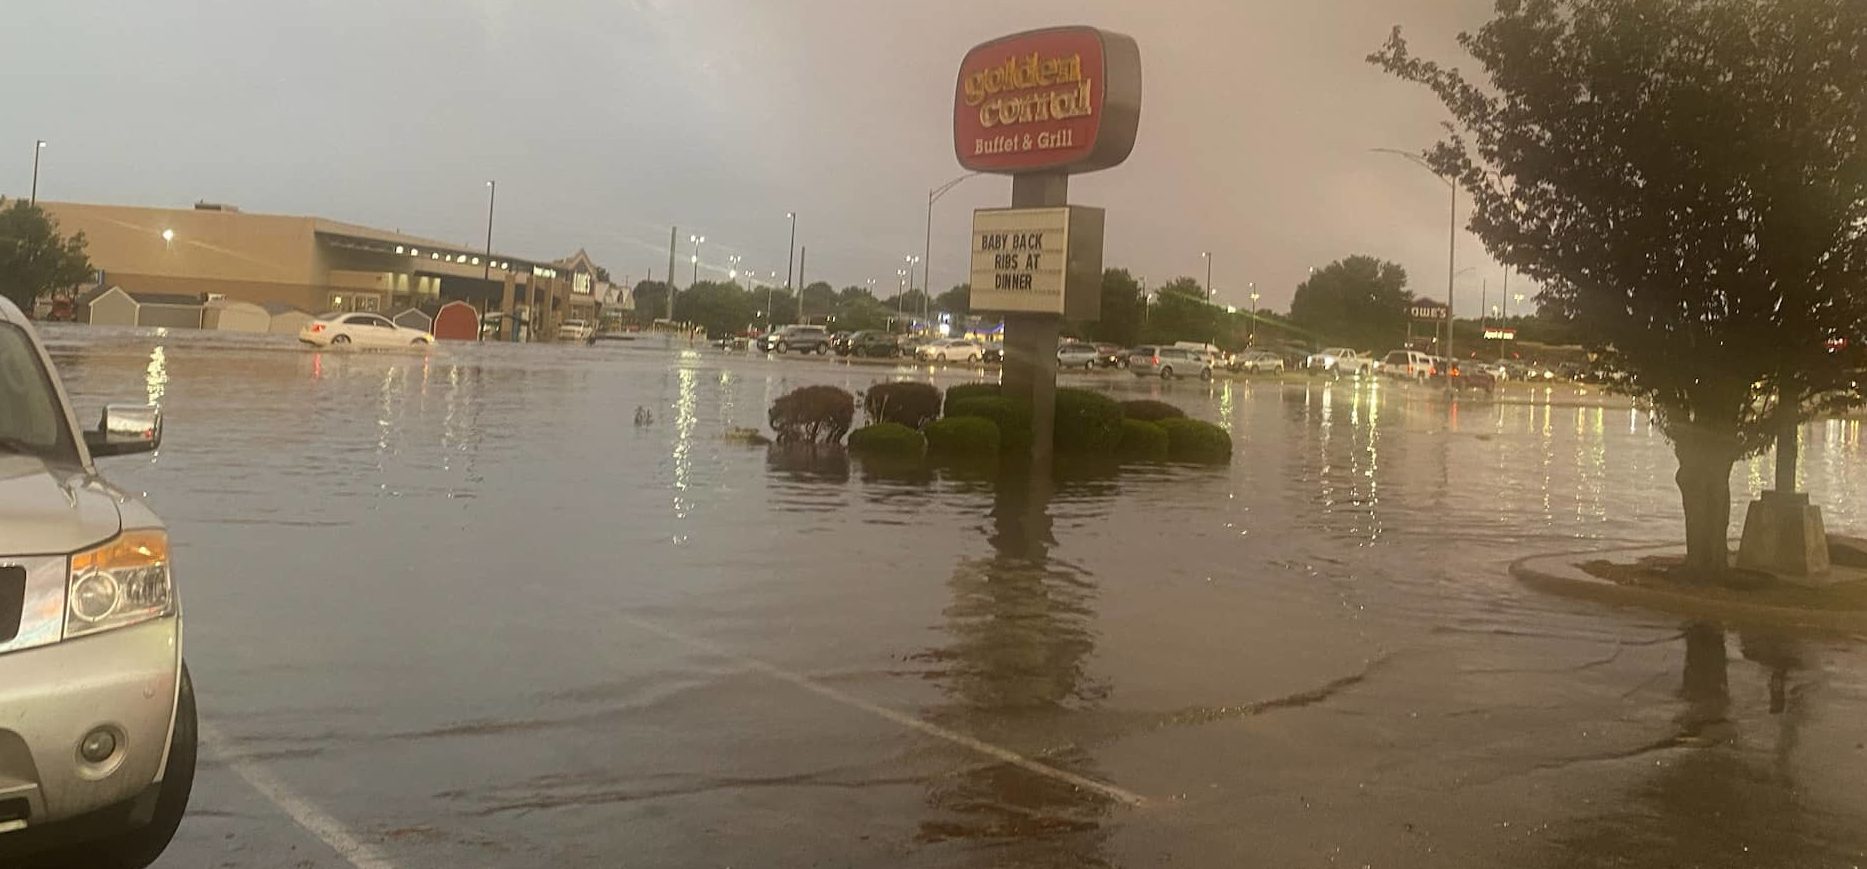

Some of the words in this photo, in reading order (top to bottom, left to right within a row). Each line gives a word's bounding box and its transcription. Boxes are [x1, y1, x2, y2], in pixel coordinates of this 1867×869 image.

[965, 52, 1082, 106] golden
[980, 78, 1092, 128] corral
[975, 135, 1020, 155] Buffet
[1022, 134, 1032, 151] &
[1037, 129, 1073, 149] Grill
[981, 234, 1008, 251] BABY
[1012, 232, 1043, 250] BACK
[994, 253, 1019, 270] RIBS
[1025, 253, 1041, 270] AT
[995, 273, 1032, 290] DINNER
[1405, 305, 1447, 318] OWE'S
